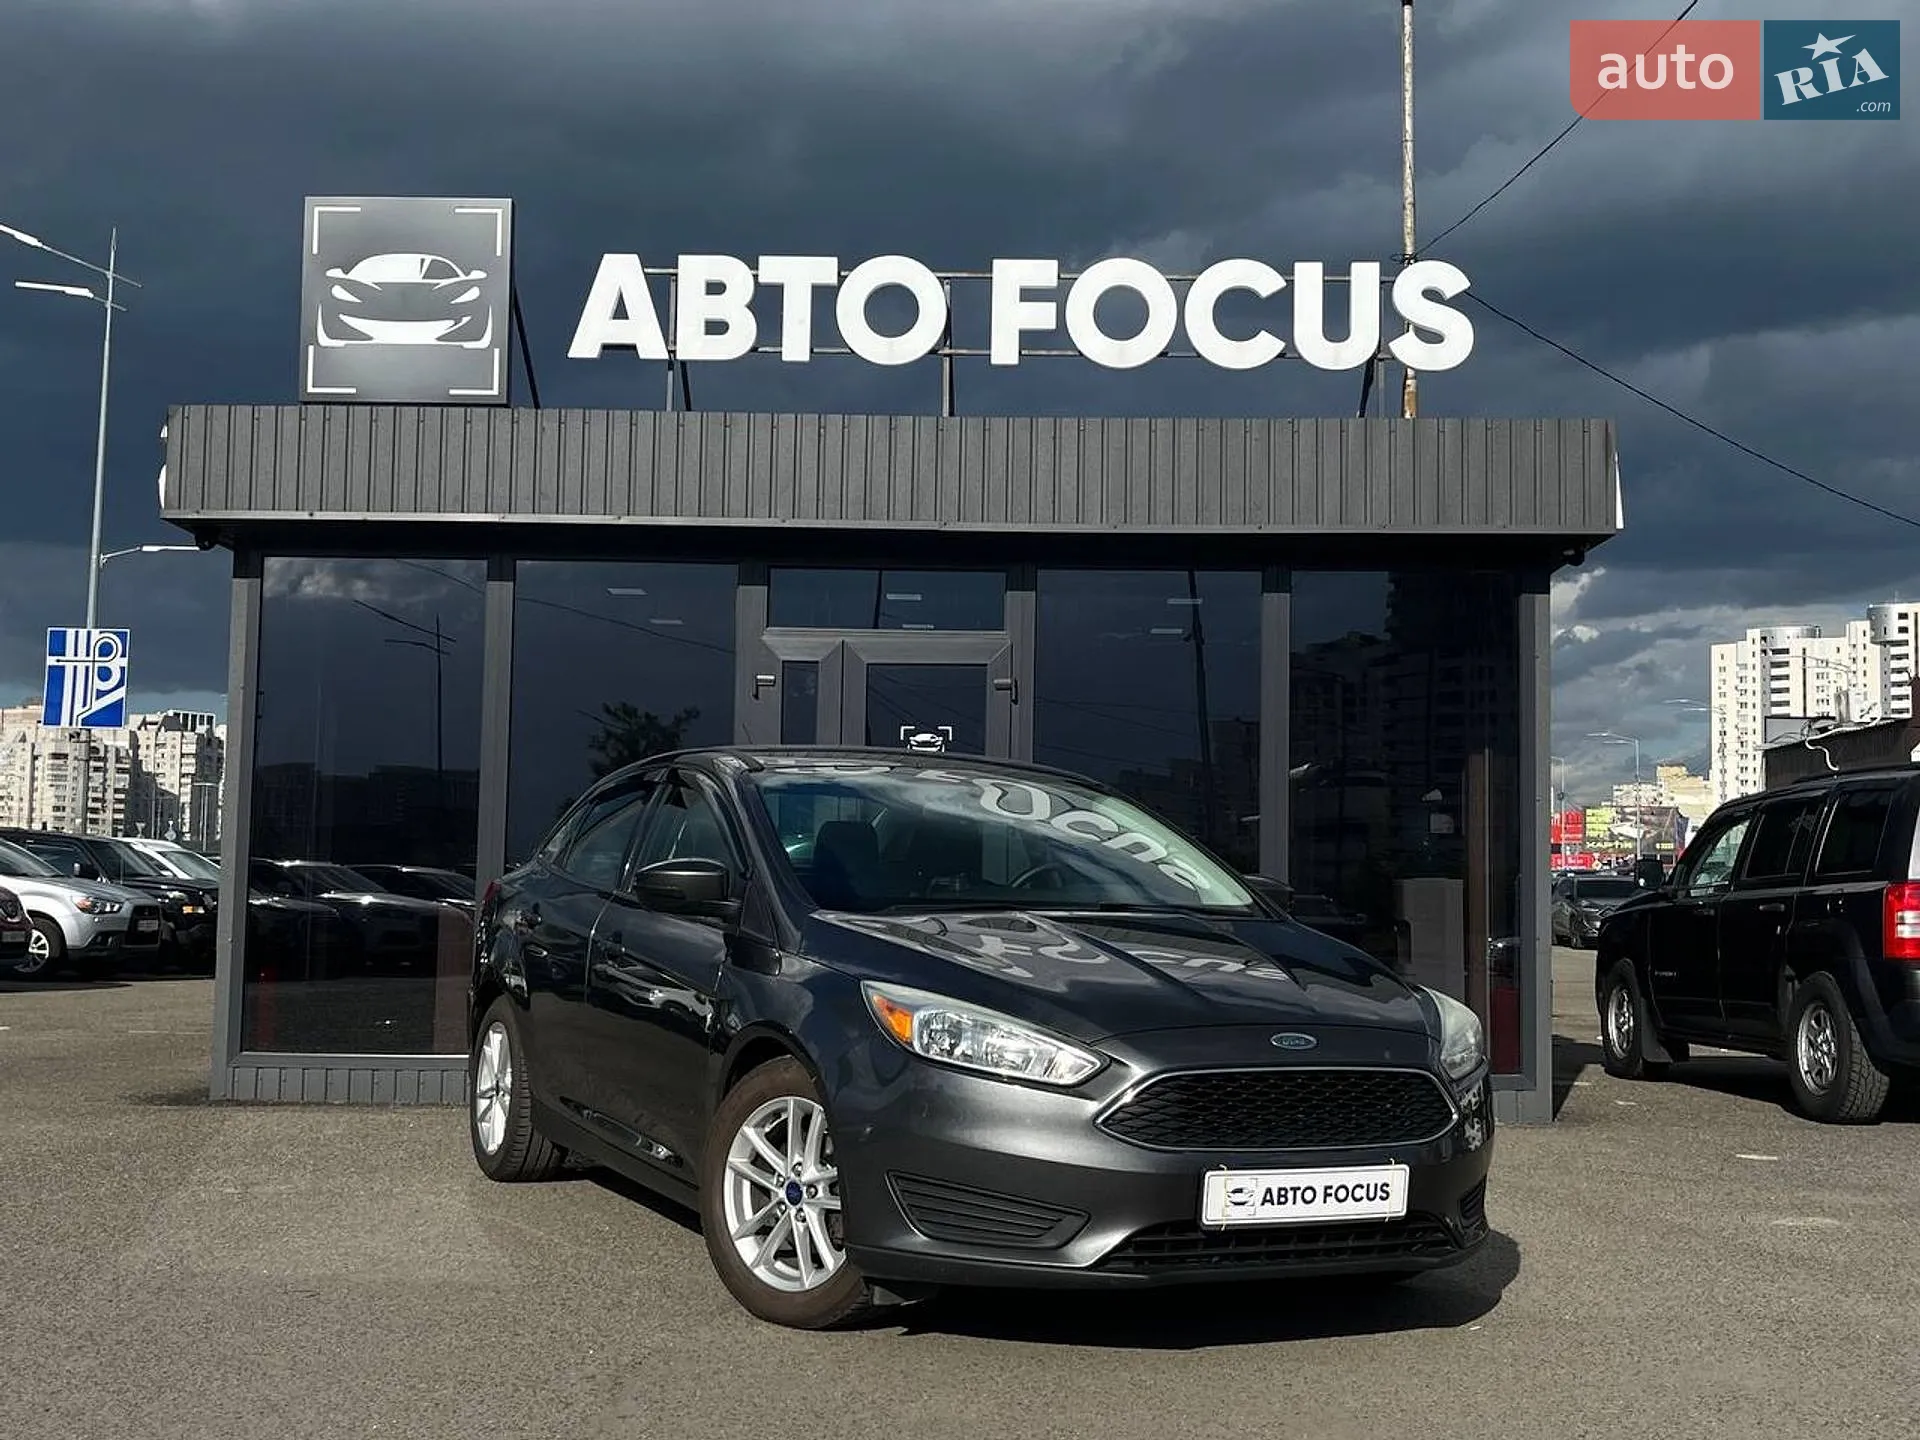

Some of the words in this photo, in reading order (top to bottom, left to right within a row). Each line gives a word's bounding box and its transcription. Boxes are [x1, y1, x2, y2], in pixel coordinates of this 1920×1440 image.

[567, 253, 947, 366] АВТО
[990, 258, 1475, 371] FOCUS
[1260, 1186, 1317, 1206] АВТО
[1322, 1182, 1391, 1205] FOCUS
